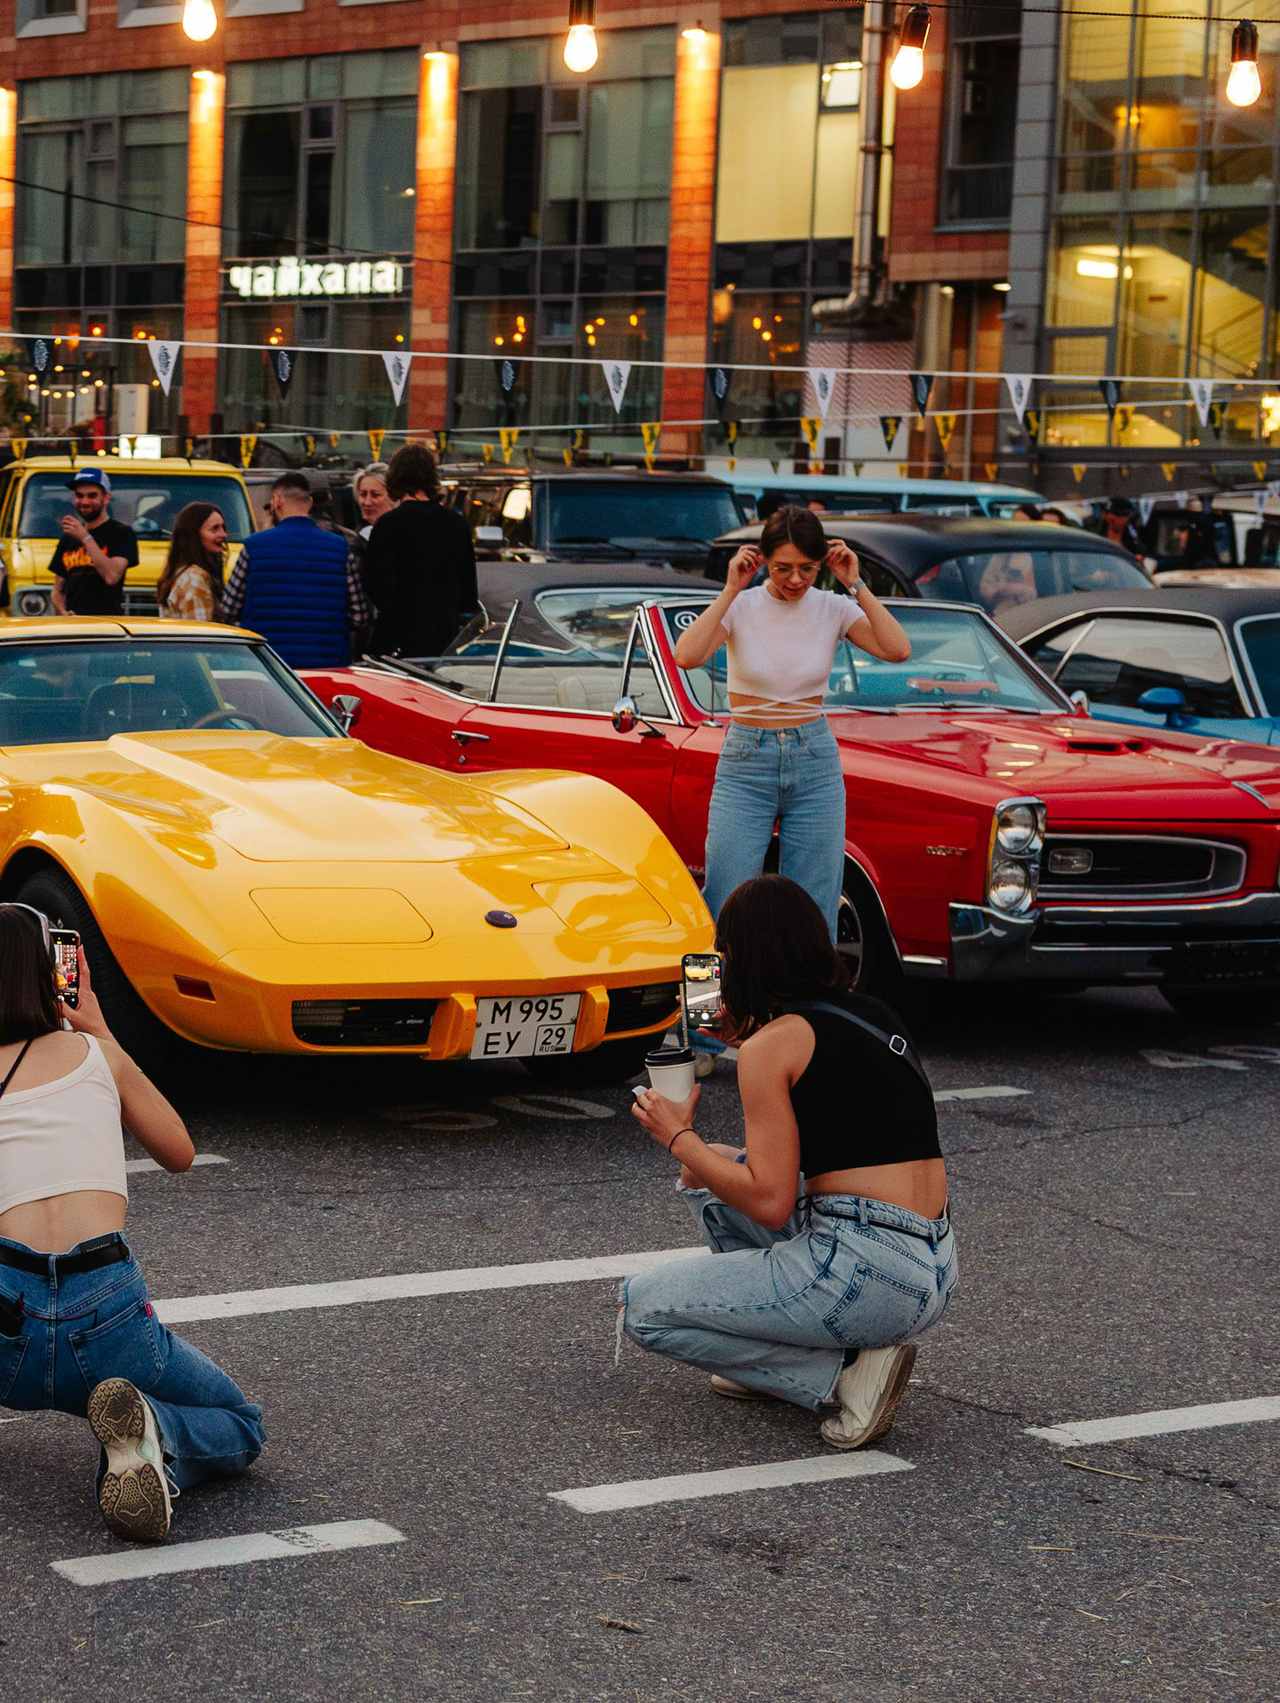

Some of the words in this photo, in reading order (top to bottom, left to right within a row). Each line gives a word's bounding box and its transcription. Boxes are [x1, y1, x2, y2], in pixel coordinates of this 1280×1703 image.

[229, 257, 397, 297] чайхана
[541, 1027, 566, 1045] 29
[539, 1045, 555, 1053] RUS
